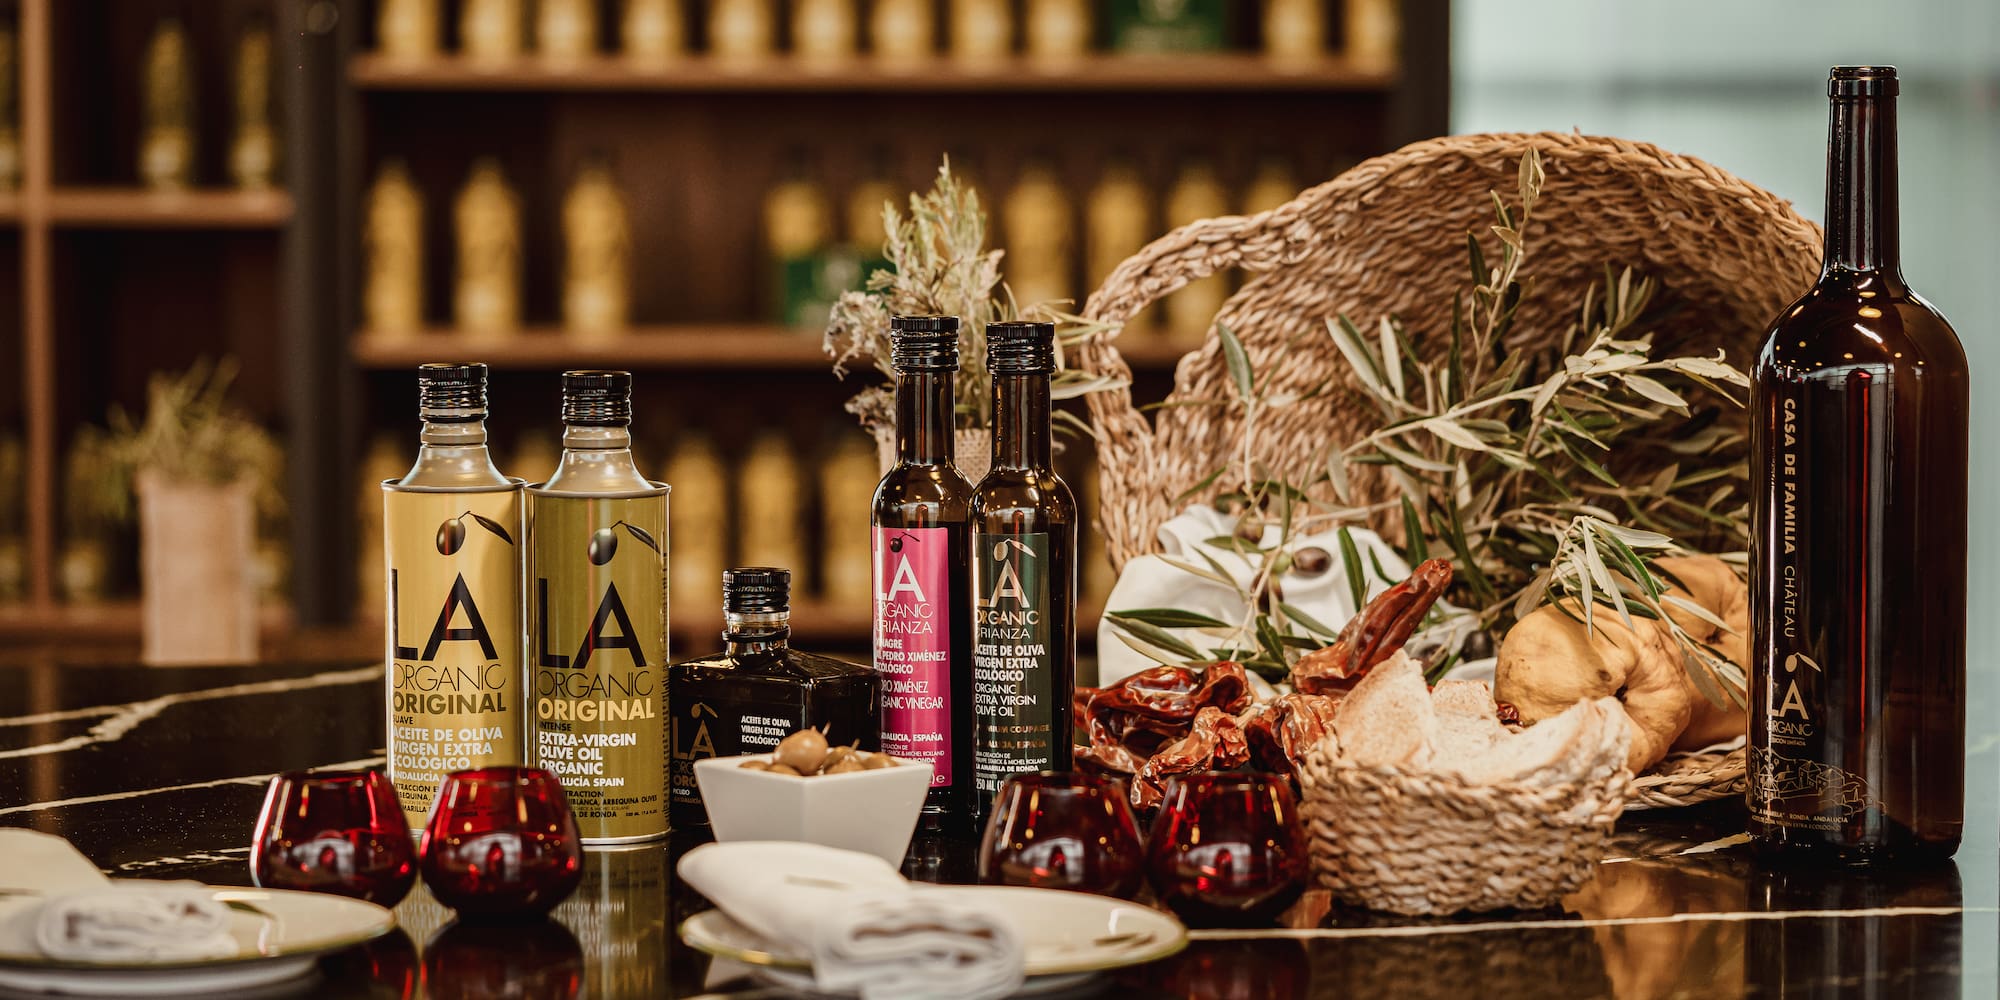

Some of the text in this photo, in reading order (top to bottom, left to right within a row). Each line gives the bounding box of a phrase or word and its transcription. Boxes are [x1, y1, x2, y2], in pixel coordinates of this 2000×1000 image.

[1784, 398, 1798, 638] CASA DE FAMILIA CHÂTEAU
[391, 568, 499, 661] LA
[538, 577, 647, 669] LA
[882, 650, 905, 662] PEDRO
[907, 649, 946, 662] XIMÉNEZ
[974, 643, 1045, 657] ACEITE DE OLIVA
[974, 656, 1039, 669] VIRGEN EXTRA
[394, 663, 507, 692] ORGANIC
[974, 667, 1025, 682] ECOLÓGICO
[538, 670, 654, 698] ORGANIC
[893, 678, 929, 694] XIMÉNEZ
[974, 682, 1017, 695] ORGANIC
[393, 692, 507, 715] ORIGINAL
[905, 696, 944, 710] VINEGAR
[975, 693, 1037, 706] EXTRA VIRGIN
[1766, 673, 1809, 720] LA
[538, 697, 656, 722] ORIGINAL
[975, 704, 1016, 717] OLIVE OIL
[540, 721, 572, 732] INTENSE
[741, 715, 791, 728] ACEITE DE OLIVA
[394, 726, 503, 742] ACEITE DE OLIVA
[539, 731, 637, 747] EXTRA-VIRGIN
[673, 716, 717, 761] LA
[741, 725, 786, 737] VIRGEN EXTRA
[912, 731, 943, 742] ESPAÑA
[741, 734, 781, 747] ECOLÓGICO
[393, 741, 493, 757] VIRGEN EXTRA
[539, 745, 603, 761] OLIVE OIL
[539, 759, 604, 775] ORGANIC
[593, 777, 625, 787] SPAIN
